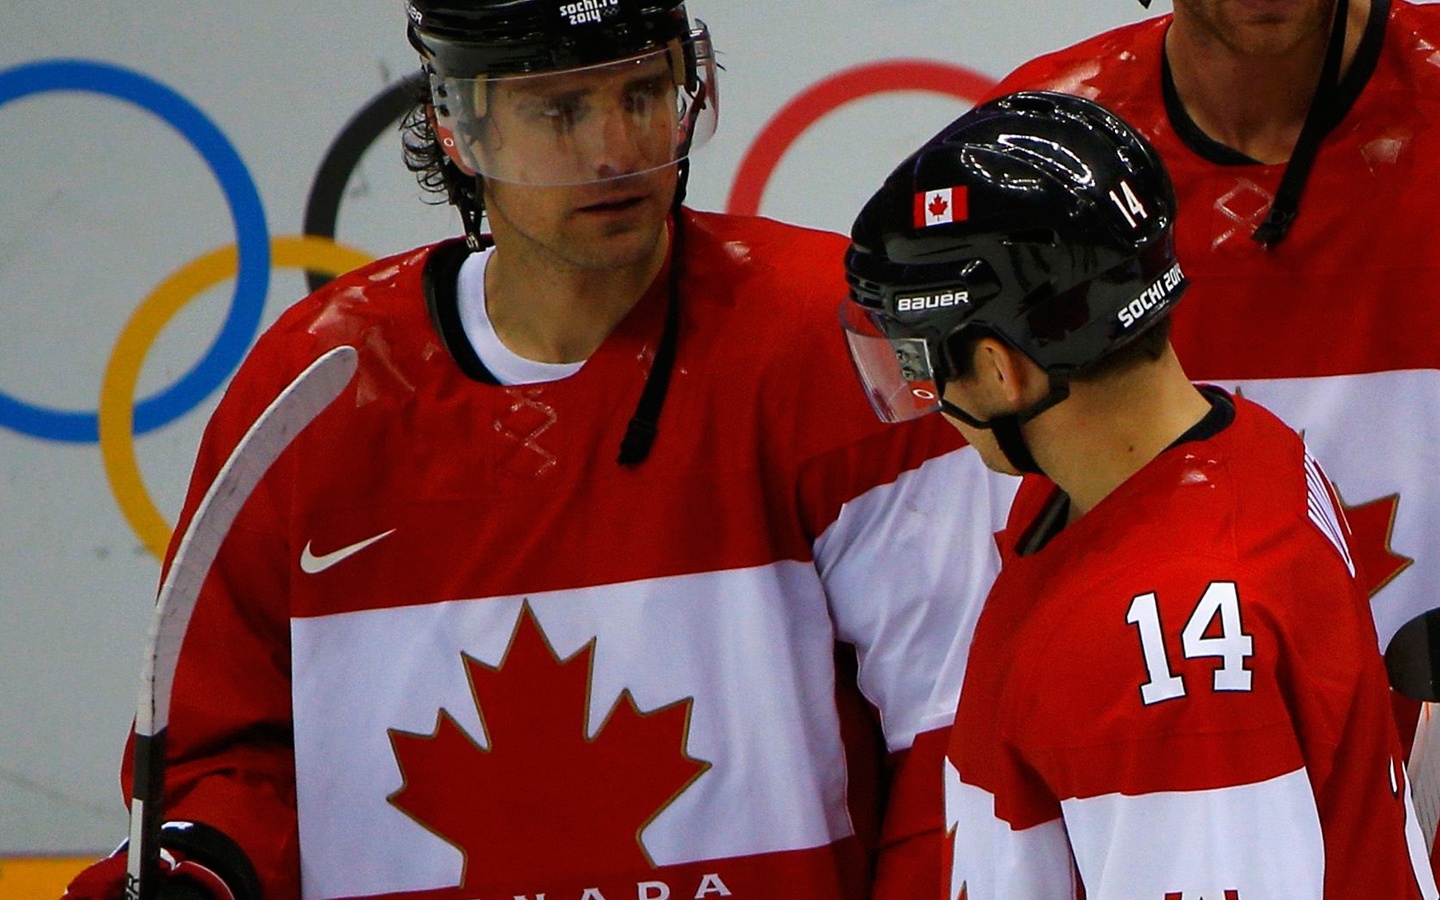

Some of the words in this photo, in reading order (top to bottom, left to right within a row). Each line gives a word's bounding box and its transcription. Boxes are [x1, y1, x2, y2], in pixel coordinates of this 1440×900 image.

[568, 9, 601, 25] 2014
[1109, 180, 1148, 228] 14
[1117, 280, 1166, 328] SOCHI
[1126, 581, 1253, 705] 14
